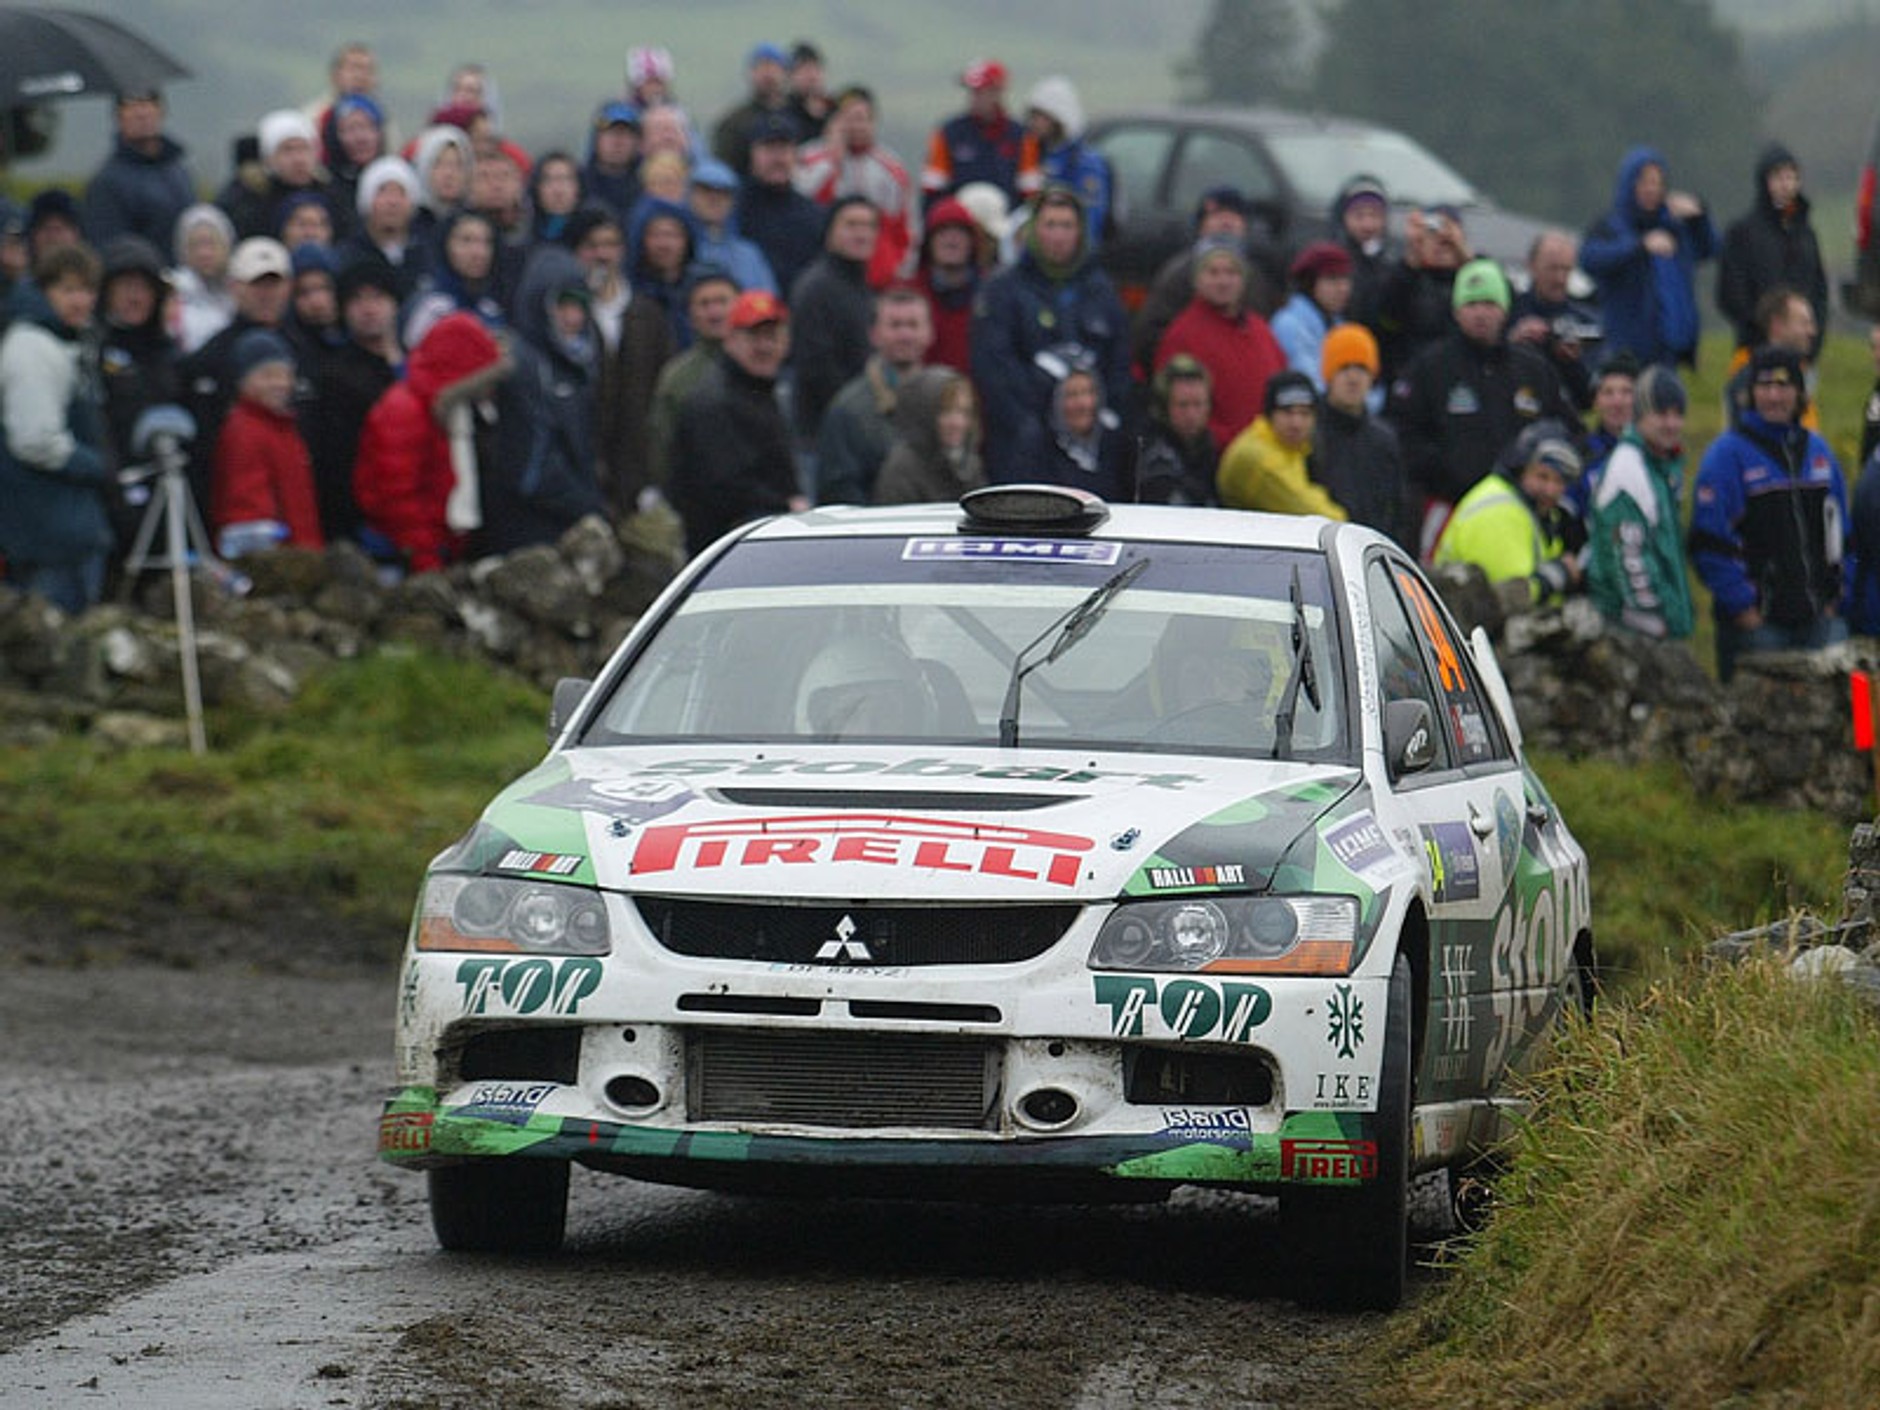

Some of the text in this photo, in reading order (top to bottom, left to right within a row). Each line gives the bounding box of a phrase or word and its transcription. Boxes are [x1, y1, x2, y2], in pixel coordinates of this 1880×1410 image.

[629, 814, 1095, 887] PIRELLI
[456, 958, 604, 1015] TOP
[1093, 975, 1273, 1042] TOP
[1164, 1106, 1250, 1130] island
